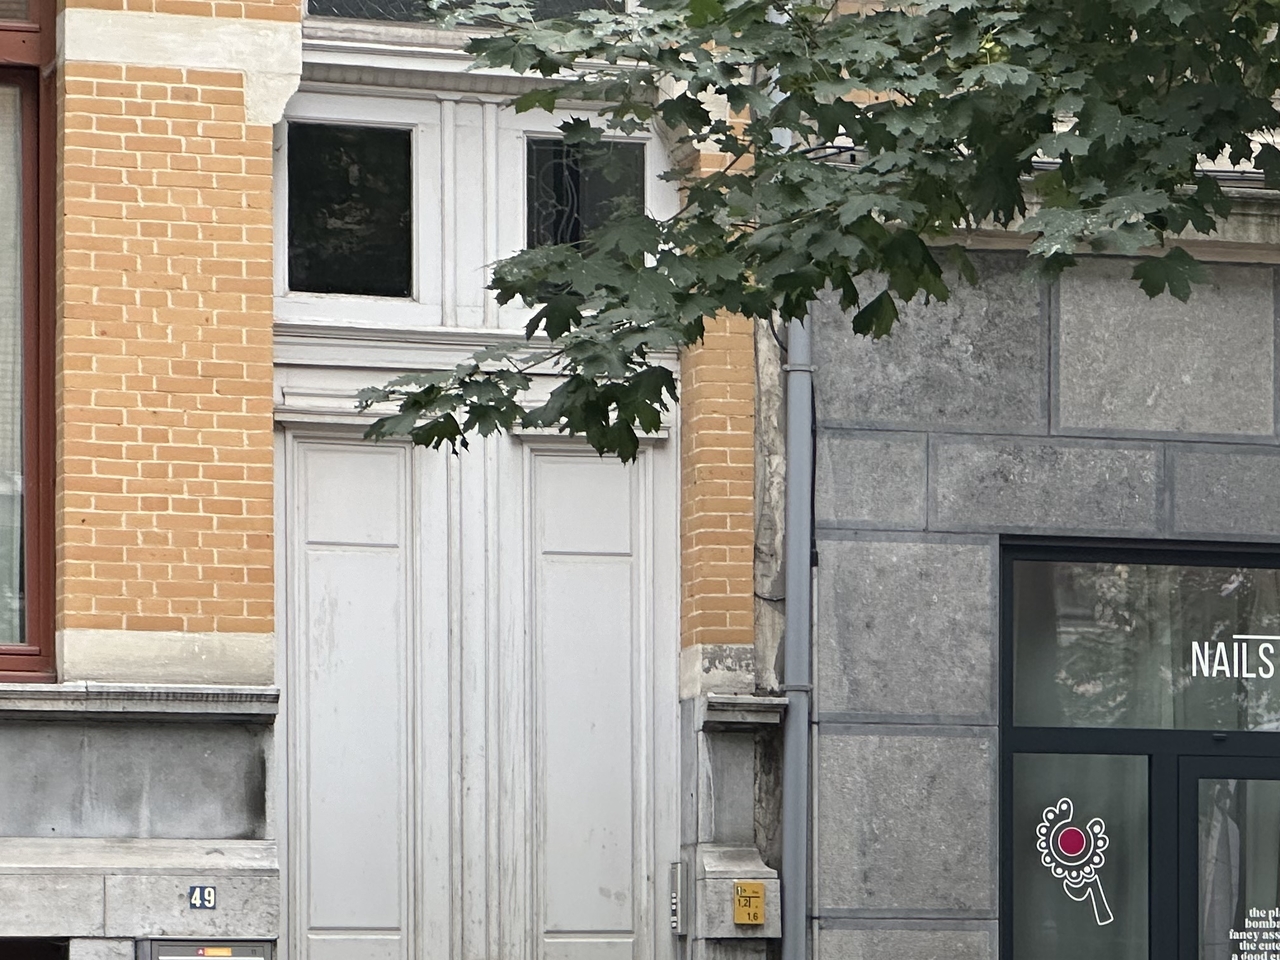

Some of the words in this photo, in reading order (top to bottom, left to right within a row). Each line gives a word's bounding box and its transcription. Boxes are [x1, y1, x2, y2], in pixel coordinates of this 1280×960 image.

[1191, 641, 1275, 679] NAILS
[190, 887, 216, 908] 49
[1249, 907, 1266, 918] the
[1229, 929, 1260, 942] fancy
[1262, 931, 1280, 940] ass
[1239, 940, 1257, 951] the
